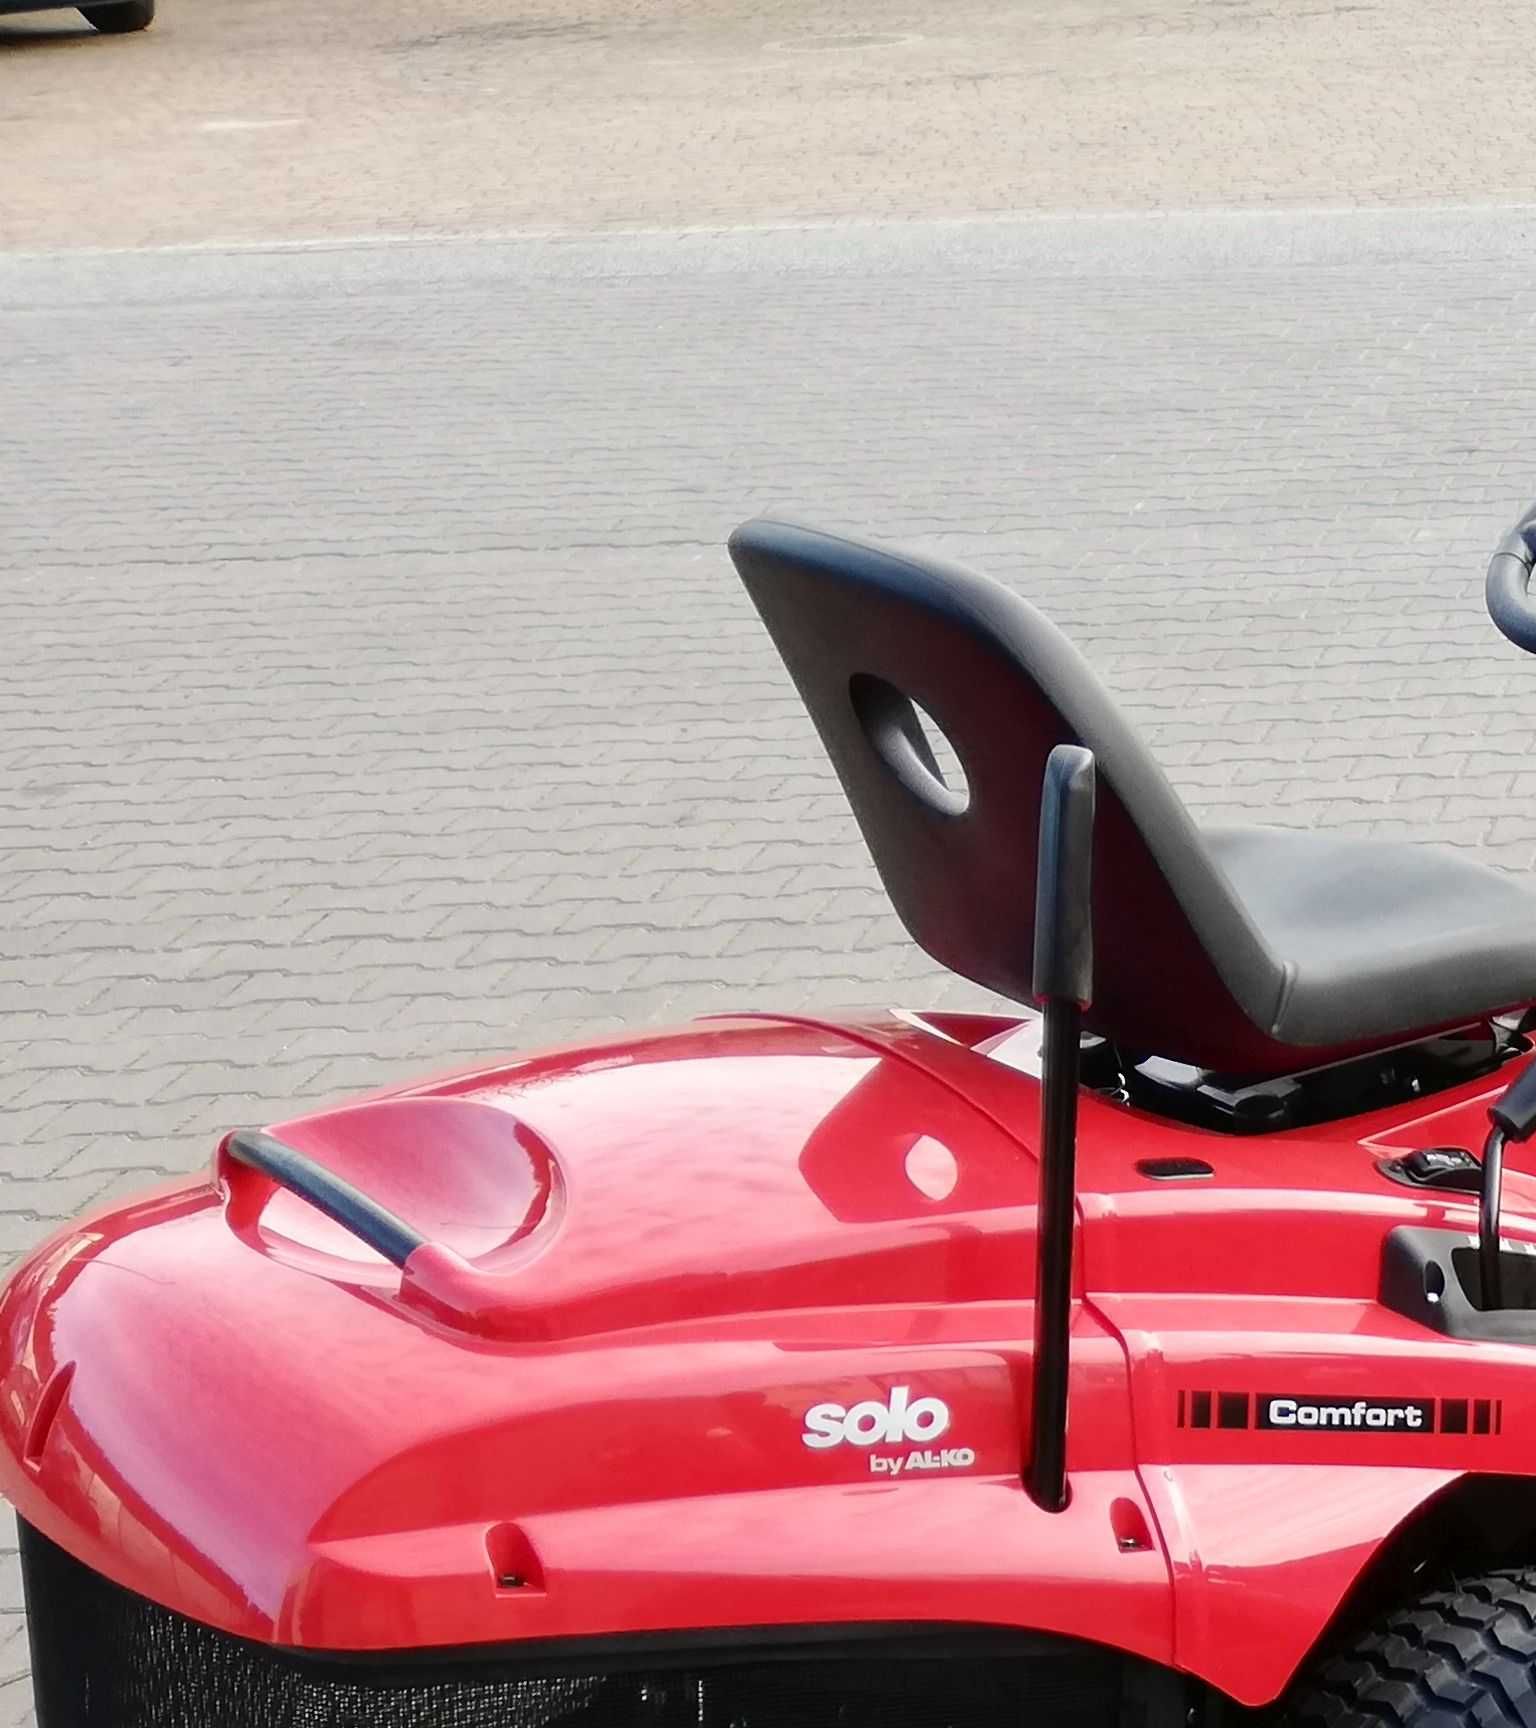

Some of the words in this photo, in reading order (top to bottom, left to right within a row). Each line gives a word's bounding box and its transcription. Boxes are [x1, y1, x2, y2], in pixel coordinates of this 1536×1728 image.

[802, 1385, 950, 1449] solo
[1268, 1399, 1423, 1428] Comfort
[869, 1454, 903, 1475] by
[904, 1447, 976, 1471] AL-KO
